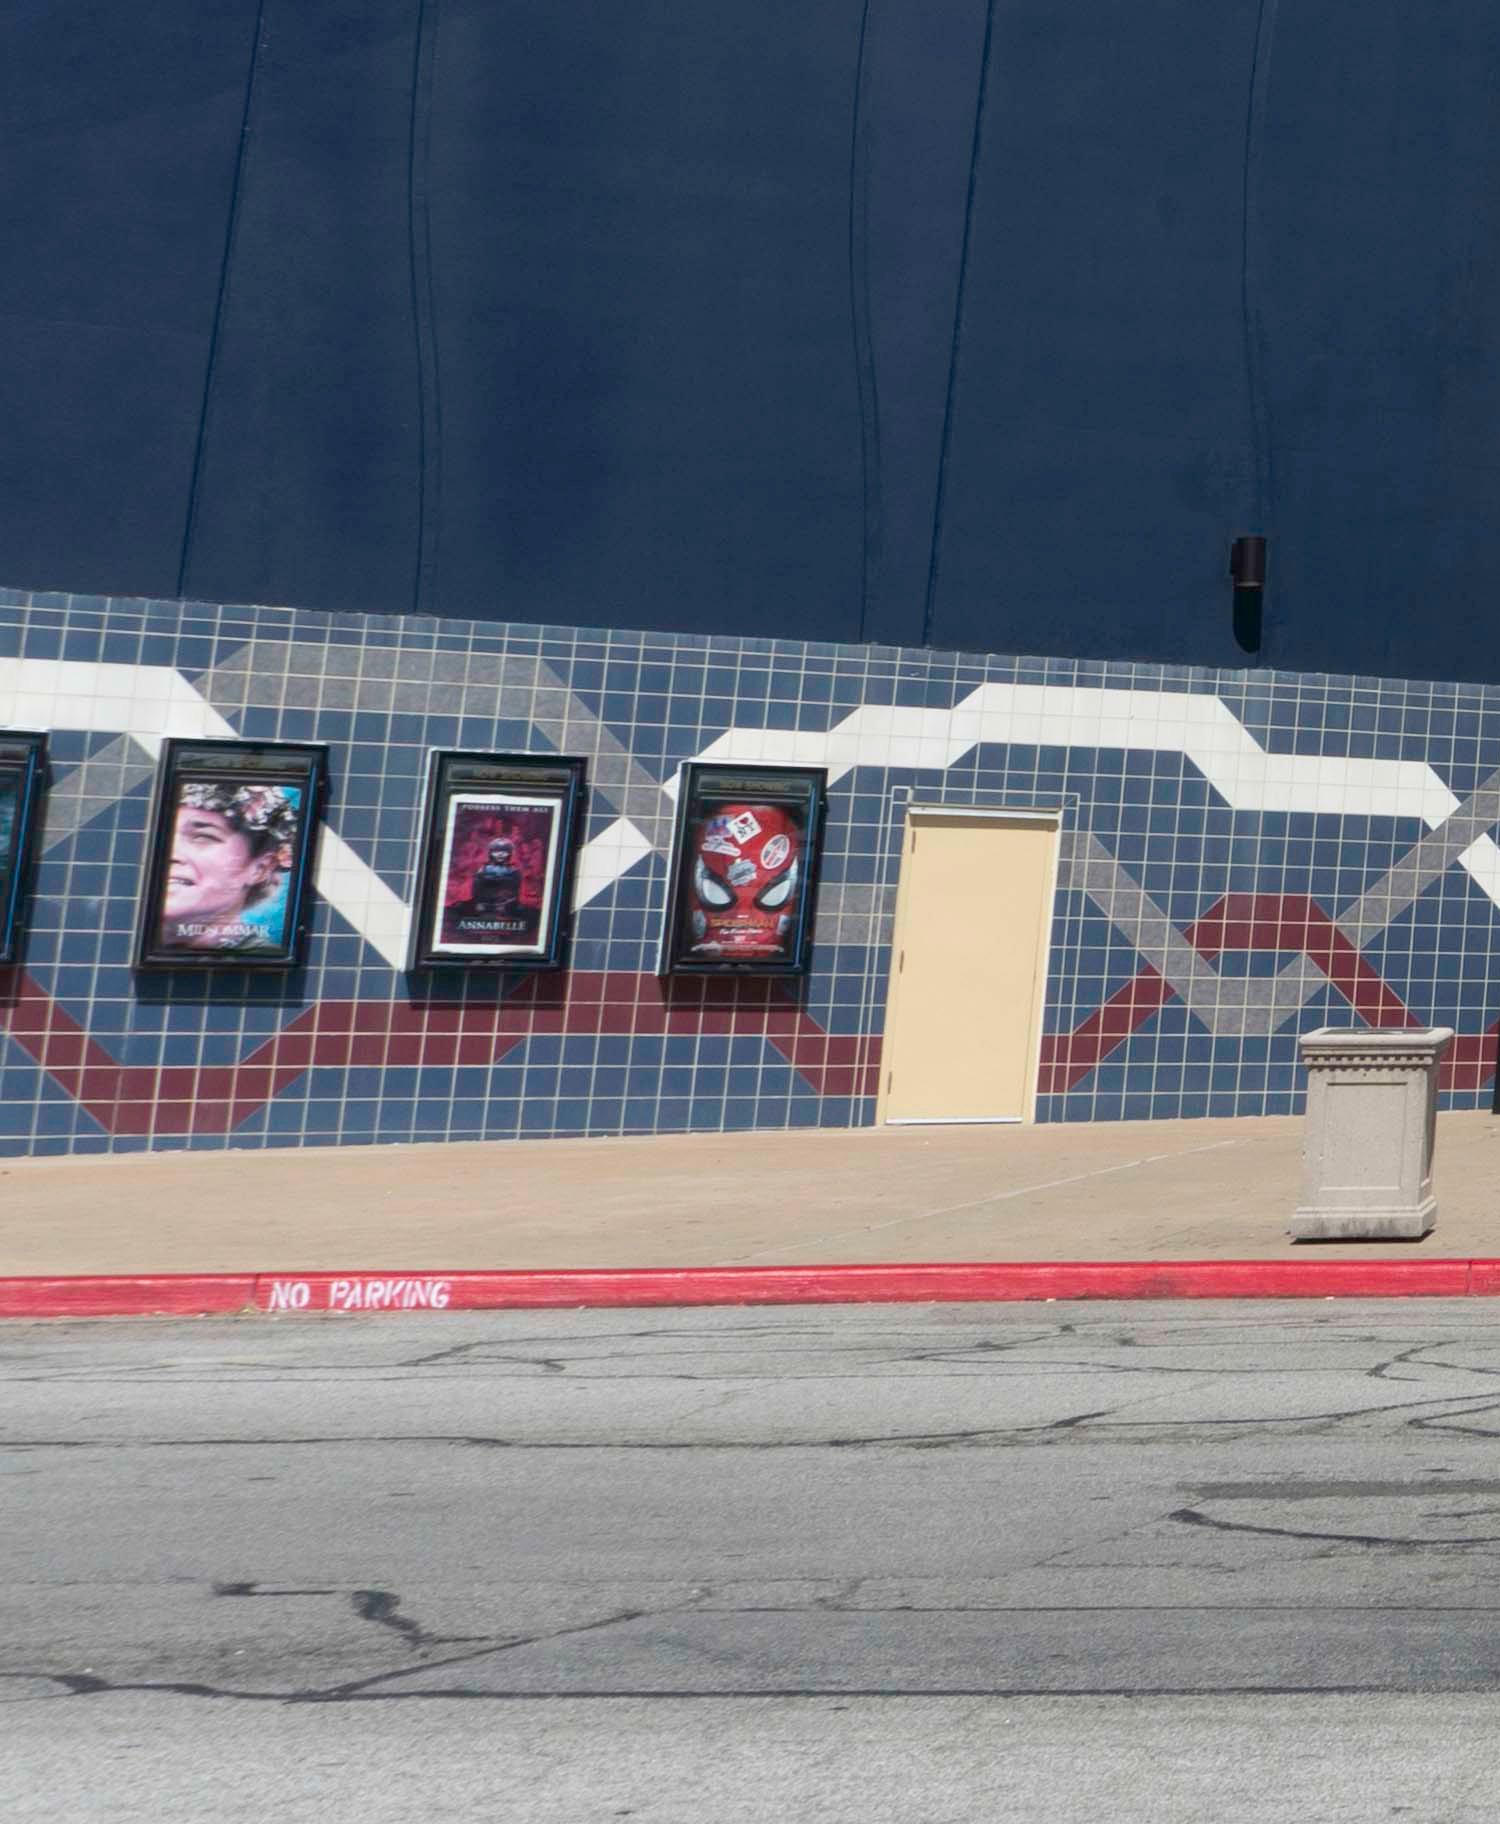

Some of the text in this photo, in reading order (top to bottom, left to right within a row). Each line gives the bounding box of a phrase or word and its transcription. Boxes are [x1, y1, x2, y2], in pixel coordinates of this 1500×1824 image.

[457, 920, 527, 931] ANNABELLE
[269, 1279, 452, 1311] NO PARKING
